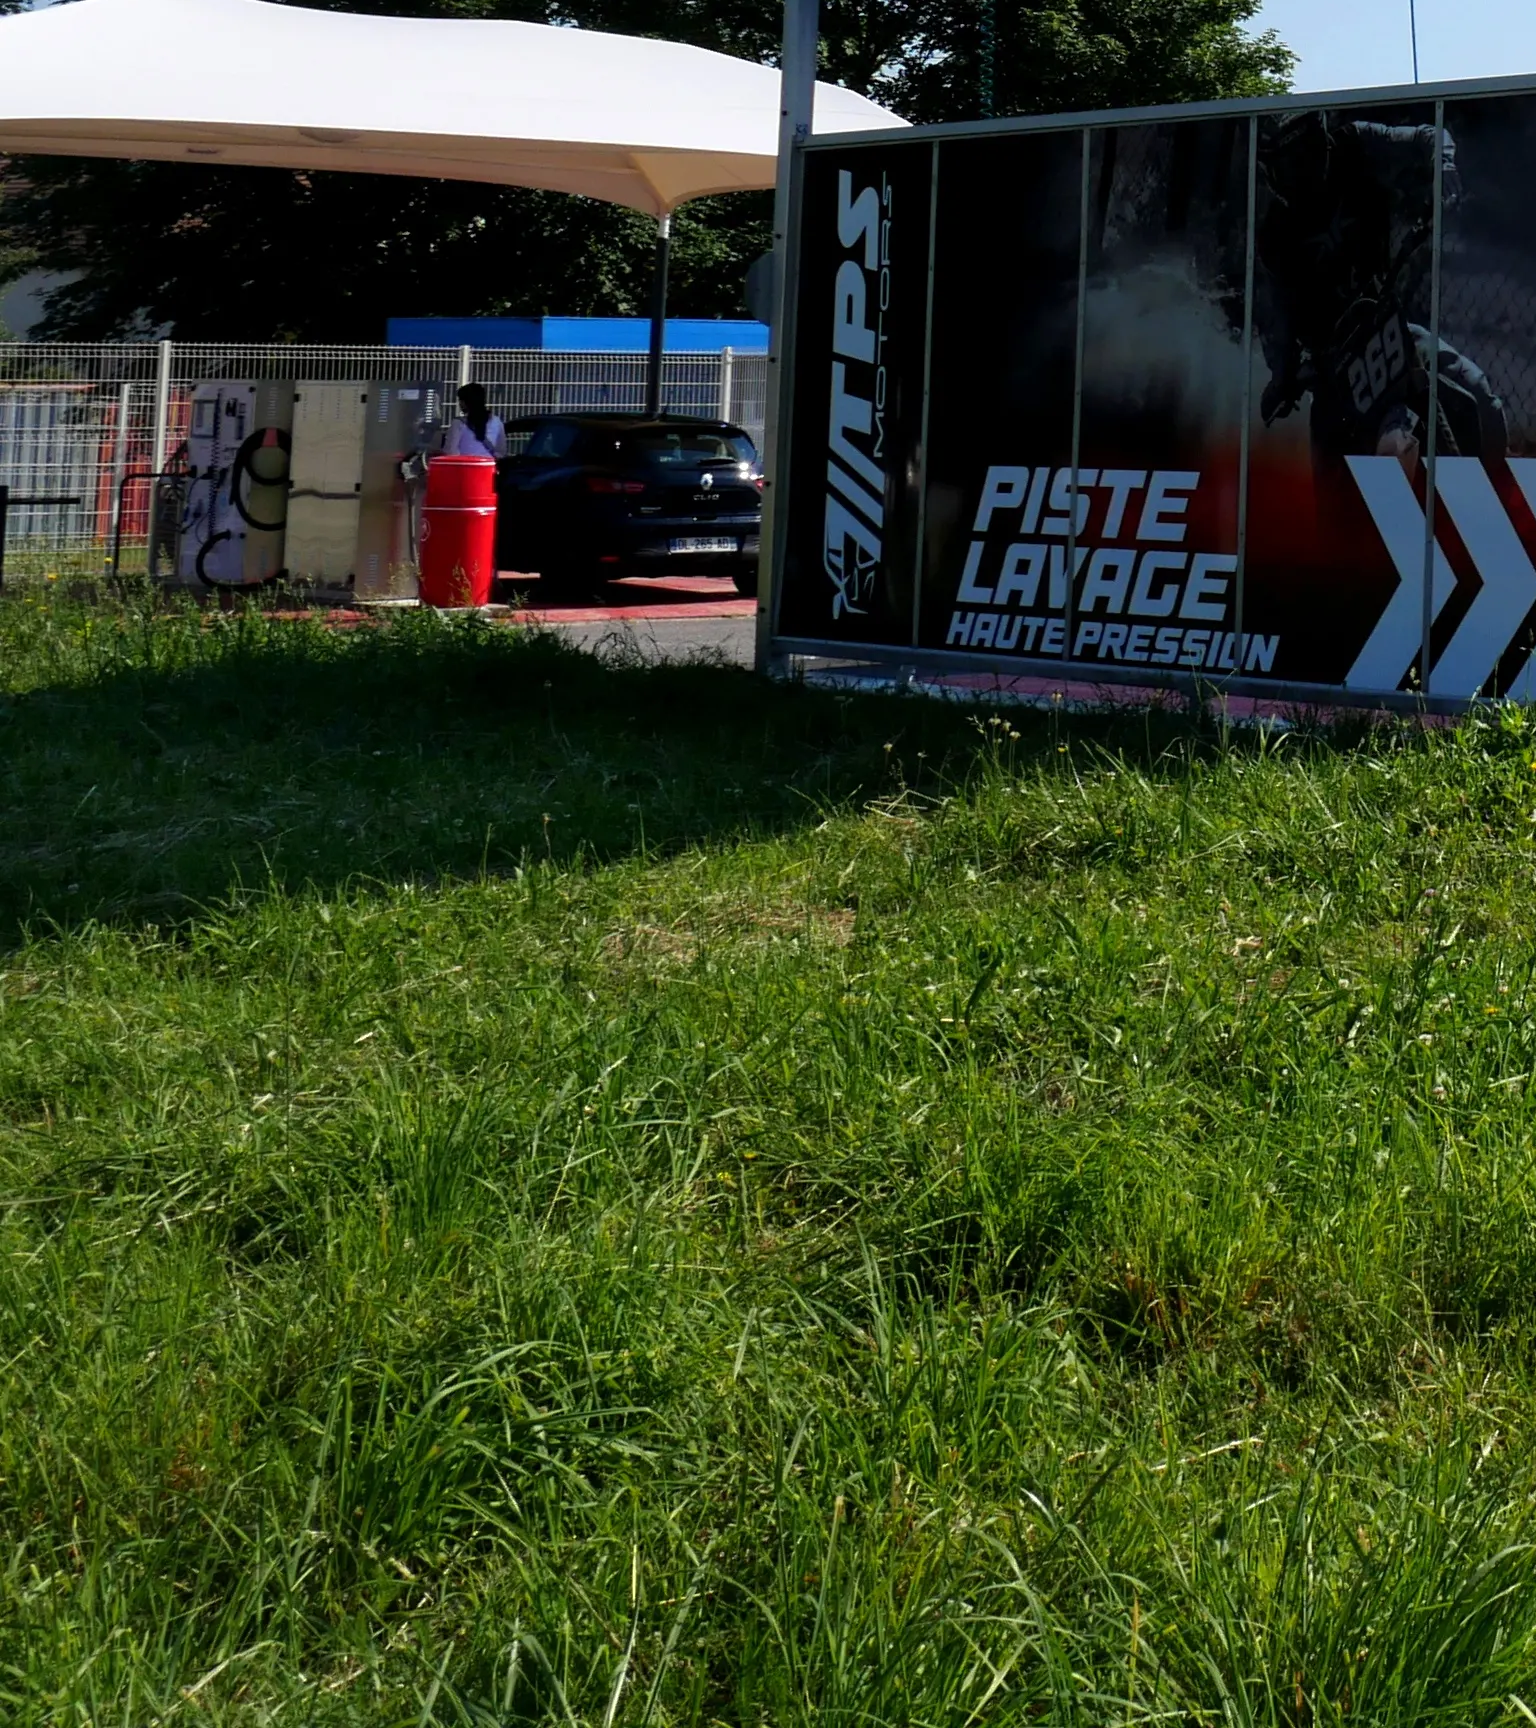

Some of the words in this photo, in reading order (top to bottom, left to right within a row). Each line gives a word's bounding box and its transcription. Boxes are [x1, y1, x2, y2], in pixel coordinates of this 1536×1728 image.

[829, 168, 885, 493] TPS
[874, 183, 892, 458] MOTORS
[1348, 312, 1405, 414] 269
[972, 466, 1200, 542] PISTE
[956, 541, 1238, 621] LAVAGE
[946, 611, 1066, 653] HAUTE
[1073, 621, 1280, 672] PRESSION
